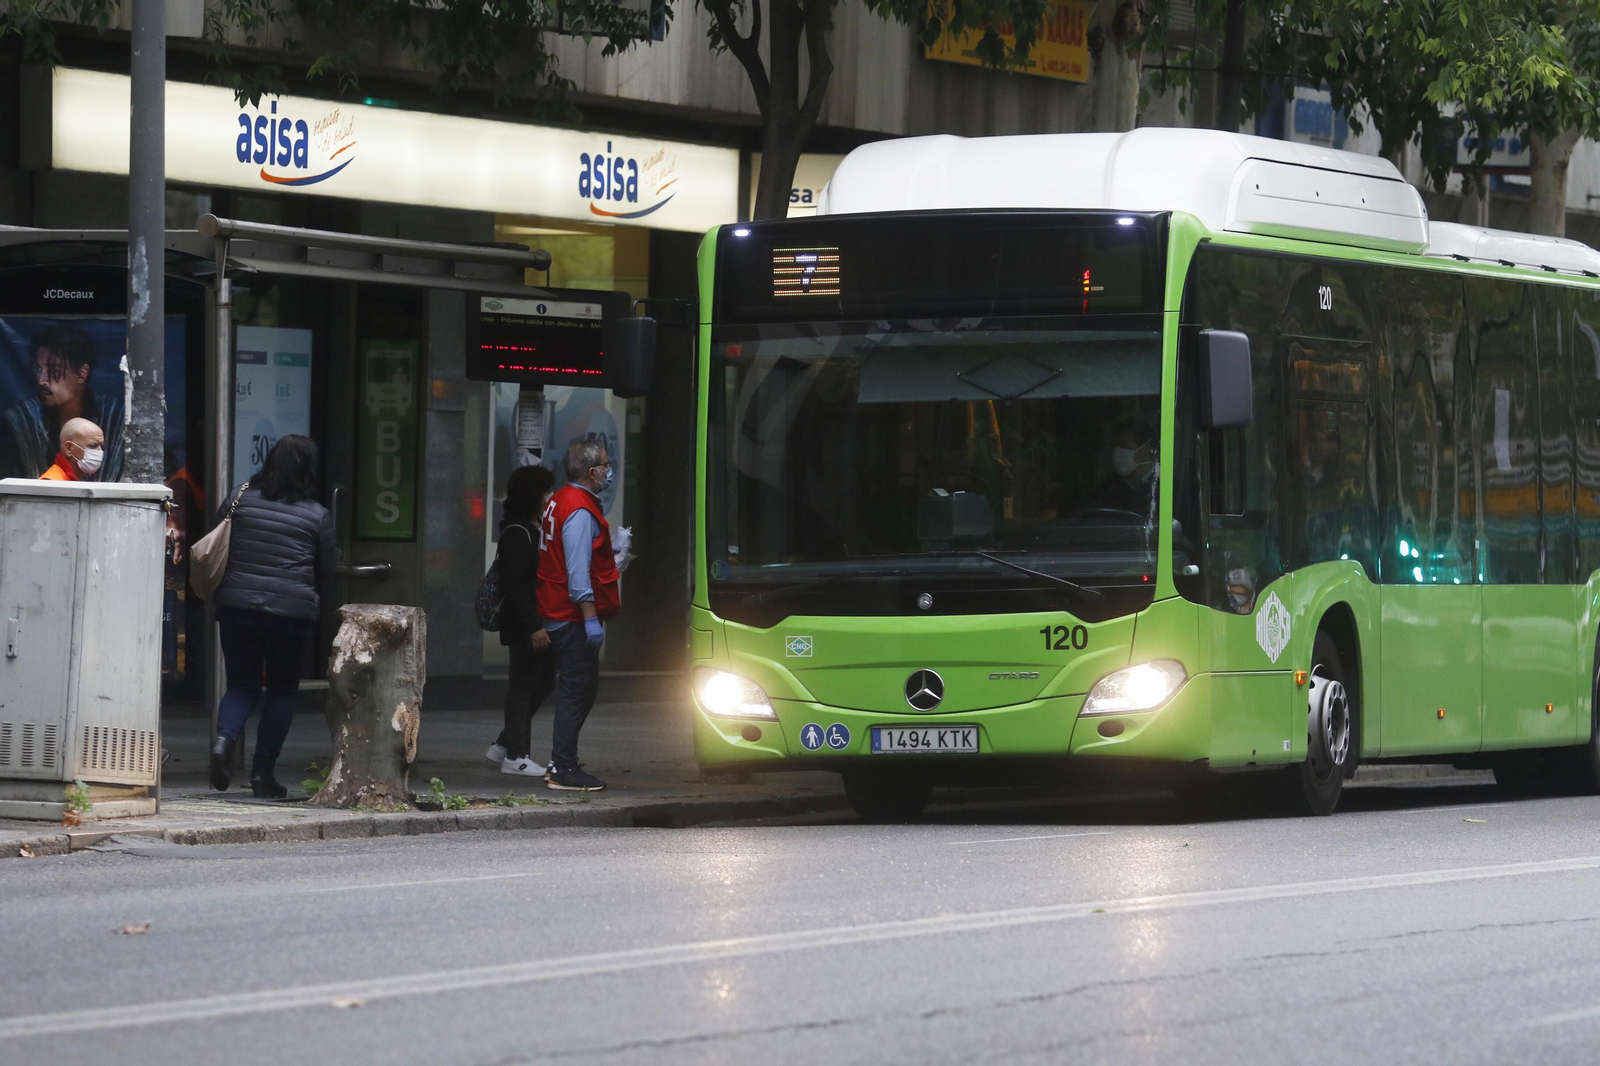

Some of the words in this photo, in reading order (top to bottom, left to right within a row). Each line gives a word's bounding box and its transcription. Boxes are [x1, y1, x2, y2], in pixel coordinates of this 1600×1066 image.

[236, 100, 309, 169] asisa
[578, 140, 638, 203] asisa
[43, 289, 95, 299] JCDecaux
[1318, 285, 1332, 311] 120
[501, 316, 525, 324] Próxima
[374, 420, 400, 524] BUS
[1039, 624, 1089, 651] 120
[988, 671, 1040, 680] CITARO
[887, 730, 931, 749] 1494
[938, 729, 973, 748] KTK
